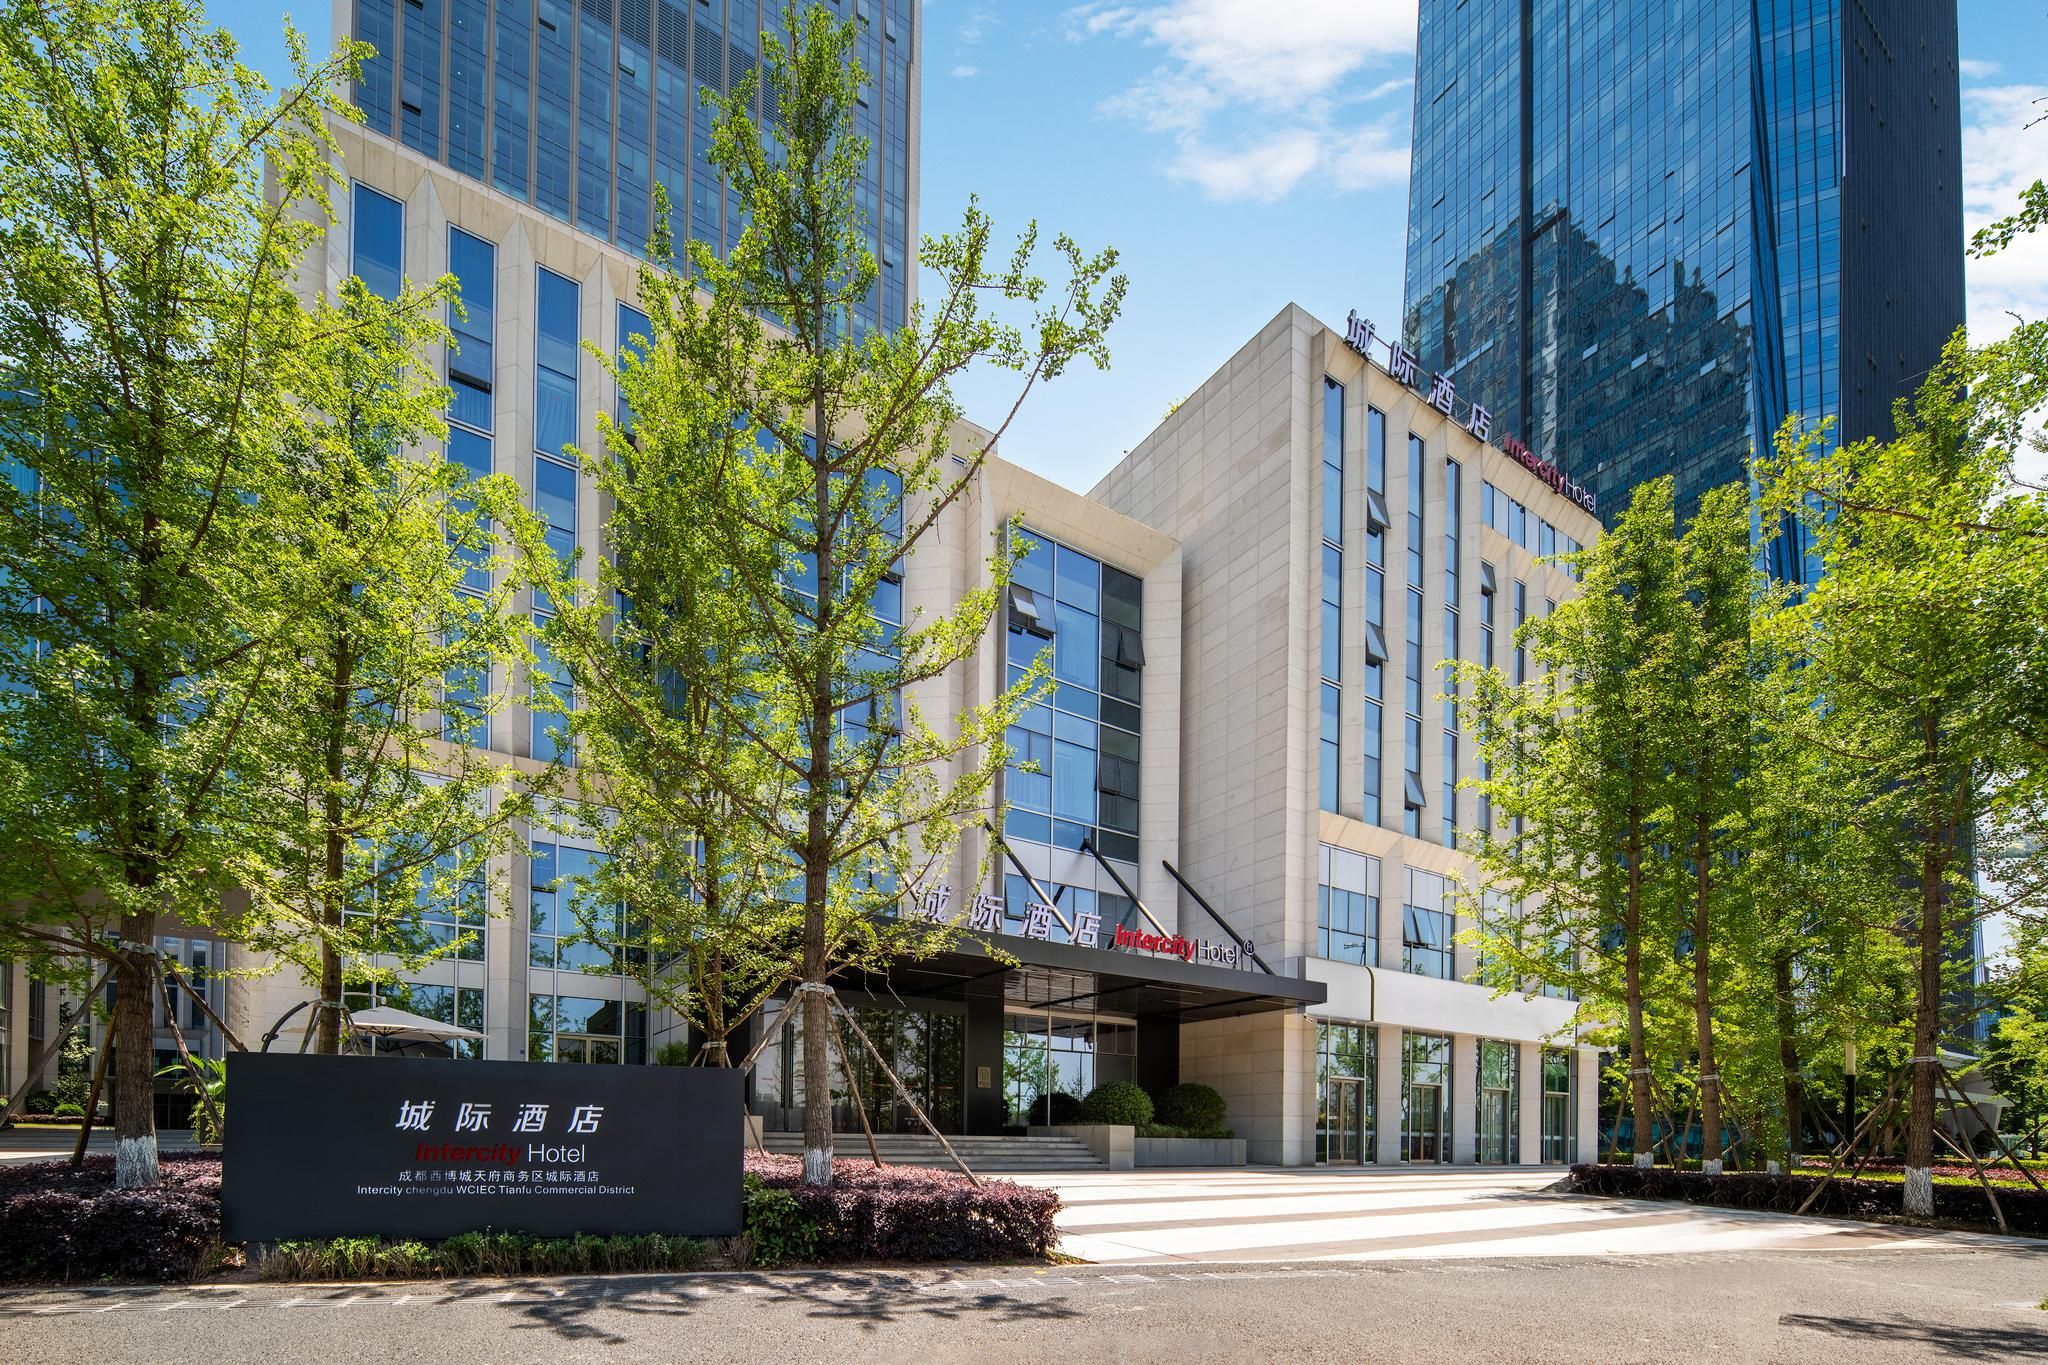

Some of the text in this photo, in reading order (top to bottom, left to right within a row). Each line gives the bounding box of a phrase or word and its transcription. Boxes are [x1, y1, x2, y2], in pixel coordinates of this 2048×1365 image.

[1345, 309, 1492, 442] 城际酒店
[910, 880, 1102, 949] 城际酒店
[395, 1100, 604, 1134] 城际酒店
[415, 1142, 586, 1166] Intercity Hotel
[357, 1185, 635, 1197] Intercity chengdu WCIEC Tianfu Commercial District
[398, 1170, 600, 1183] 成都西博城天府商务区城际酒店
